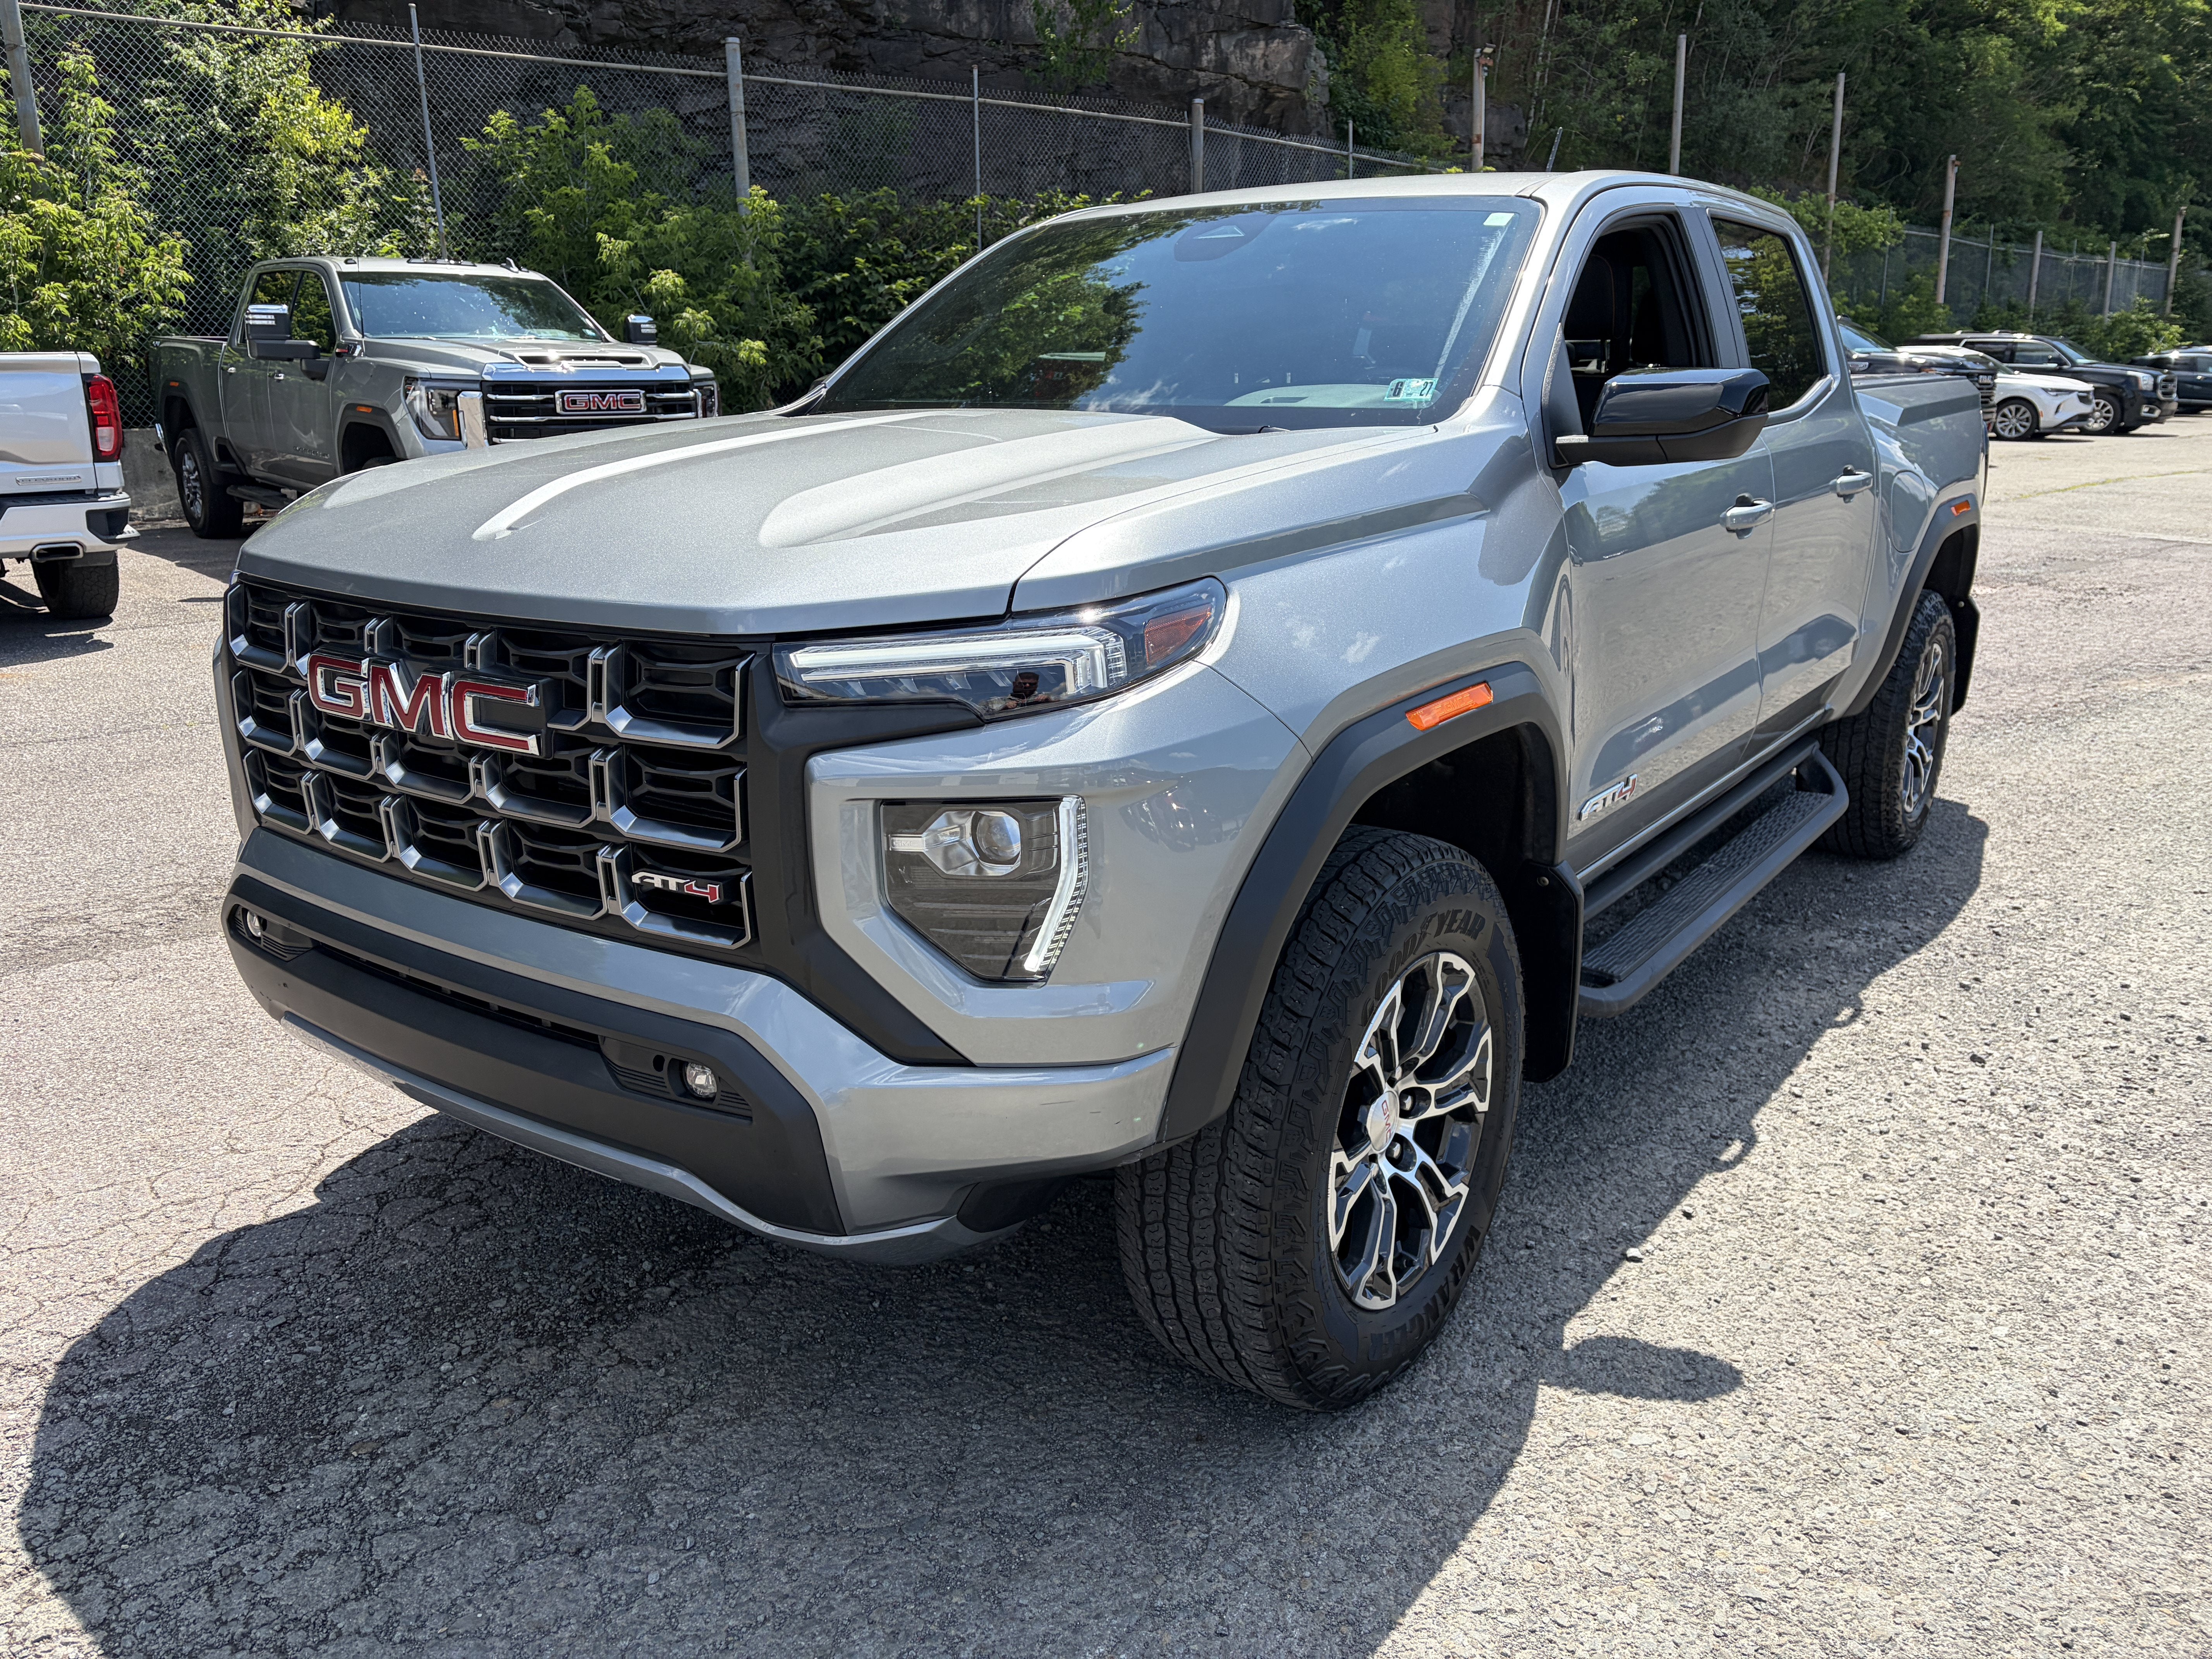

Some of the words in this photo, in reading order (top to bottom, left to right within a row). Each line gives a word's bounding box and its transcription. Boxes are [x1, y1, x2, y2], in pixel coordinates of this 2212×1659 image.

[564, 394, 641, 410] GMC
[1393, 381, 1403, 397] 6
[1419, 381, 1434, 397] 27
[307, 654, 541, 756] GMC
[1580, 774, 1637, 821] AT4
[891, 838, 918, 847] GMC
[632, 872, 720, 903] AT4
[1381, 1099, 1391, 1143] GMC
[1369, 1225, 1481, 1361] WRANGLER
